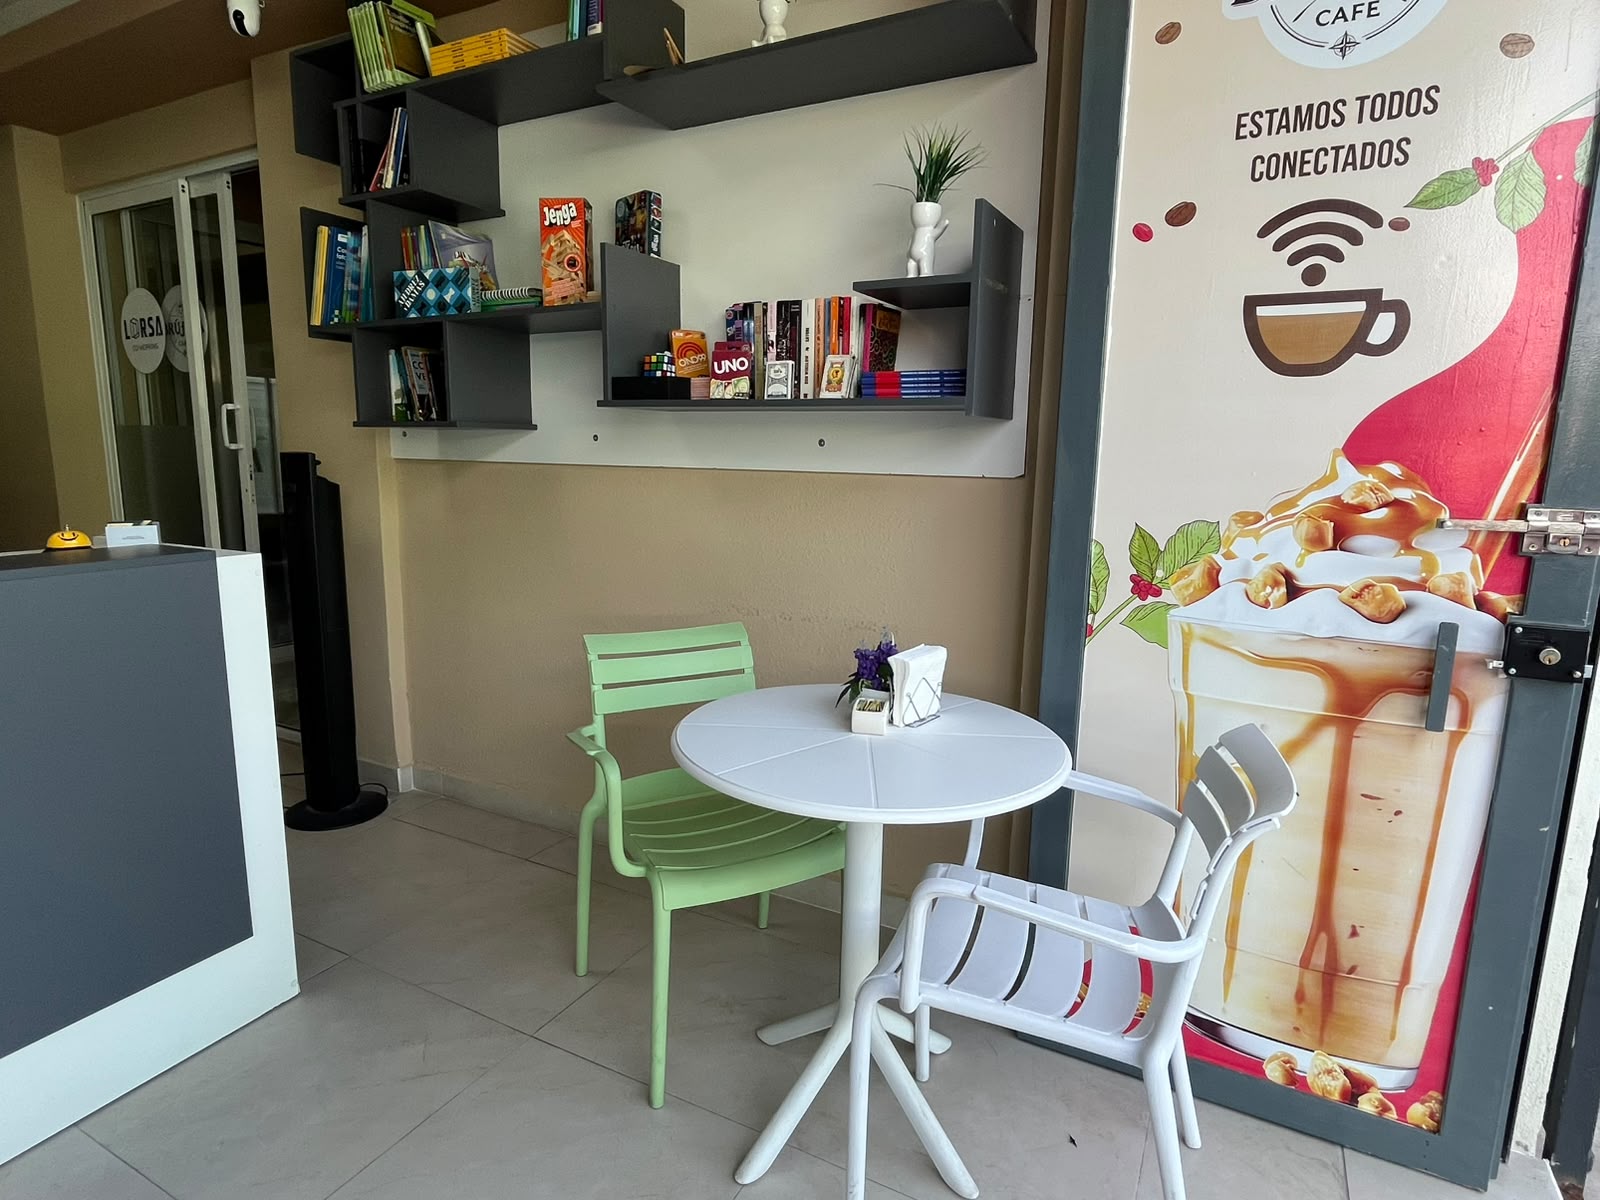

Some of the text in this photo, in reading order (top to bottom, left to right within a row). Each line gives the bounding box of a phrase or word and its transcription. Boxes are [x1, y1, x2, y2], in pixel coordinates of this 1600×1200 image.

[1315, 0, 1380, 26] CAFE
[1235, 85, 1440, 140] ESTAMOS TODOS
[1250, 137, 1411, 182] CONECTADOS
[543, 202, 577, 226] Jenga
[713, 357, 749, 374] UNO
